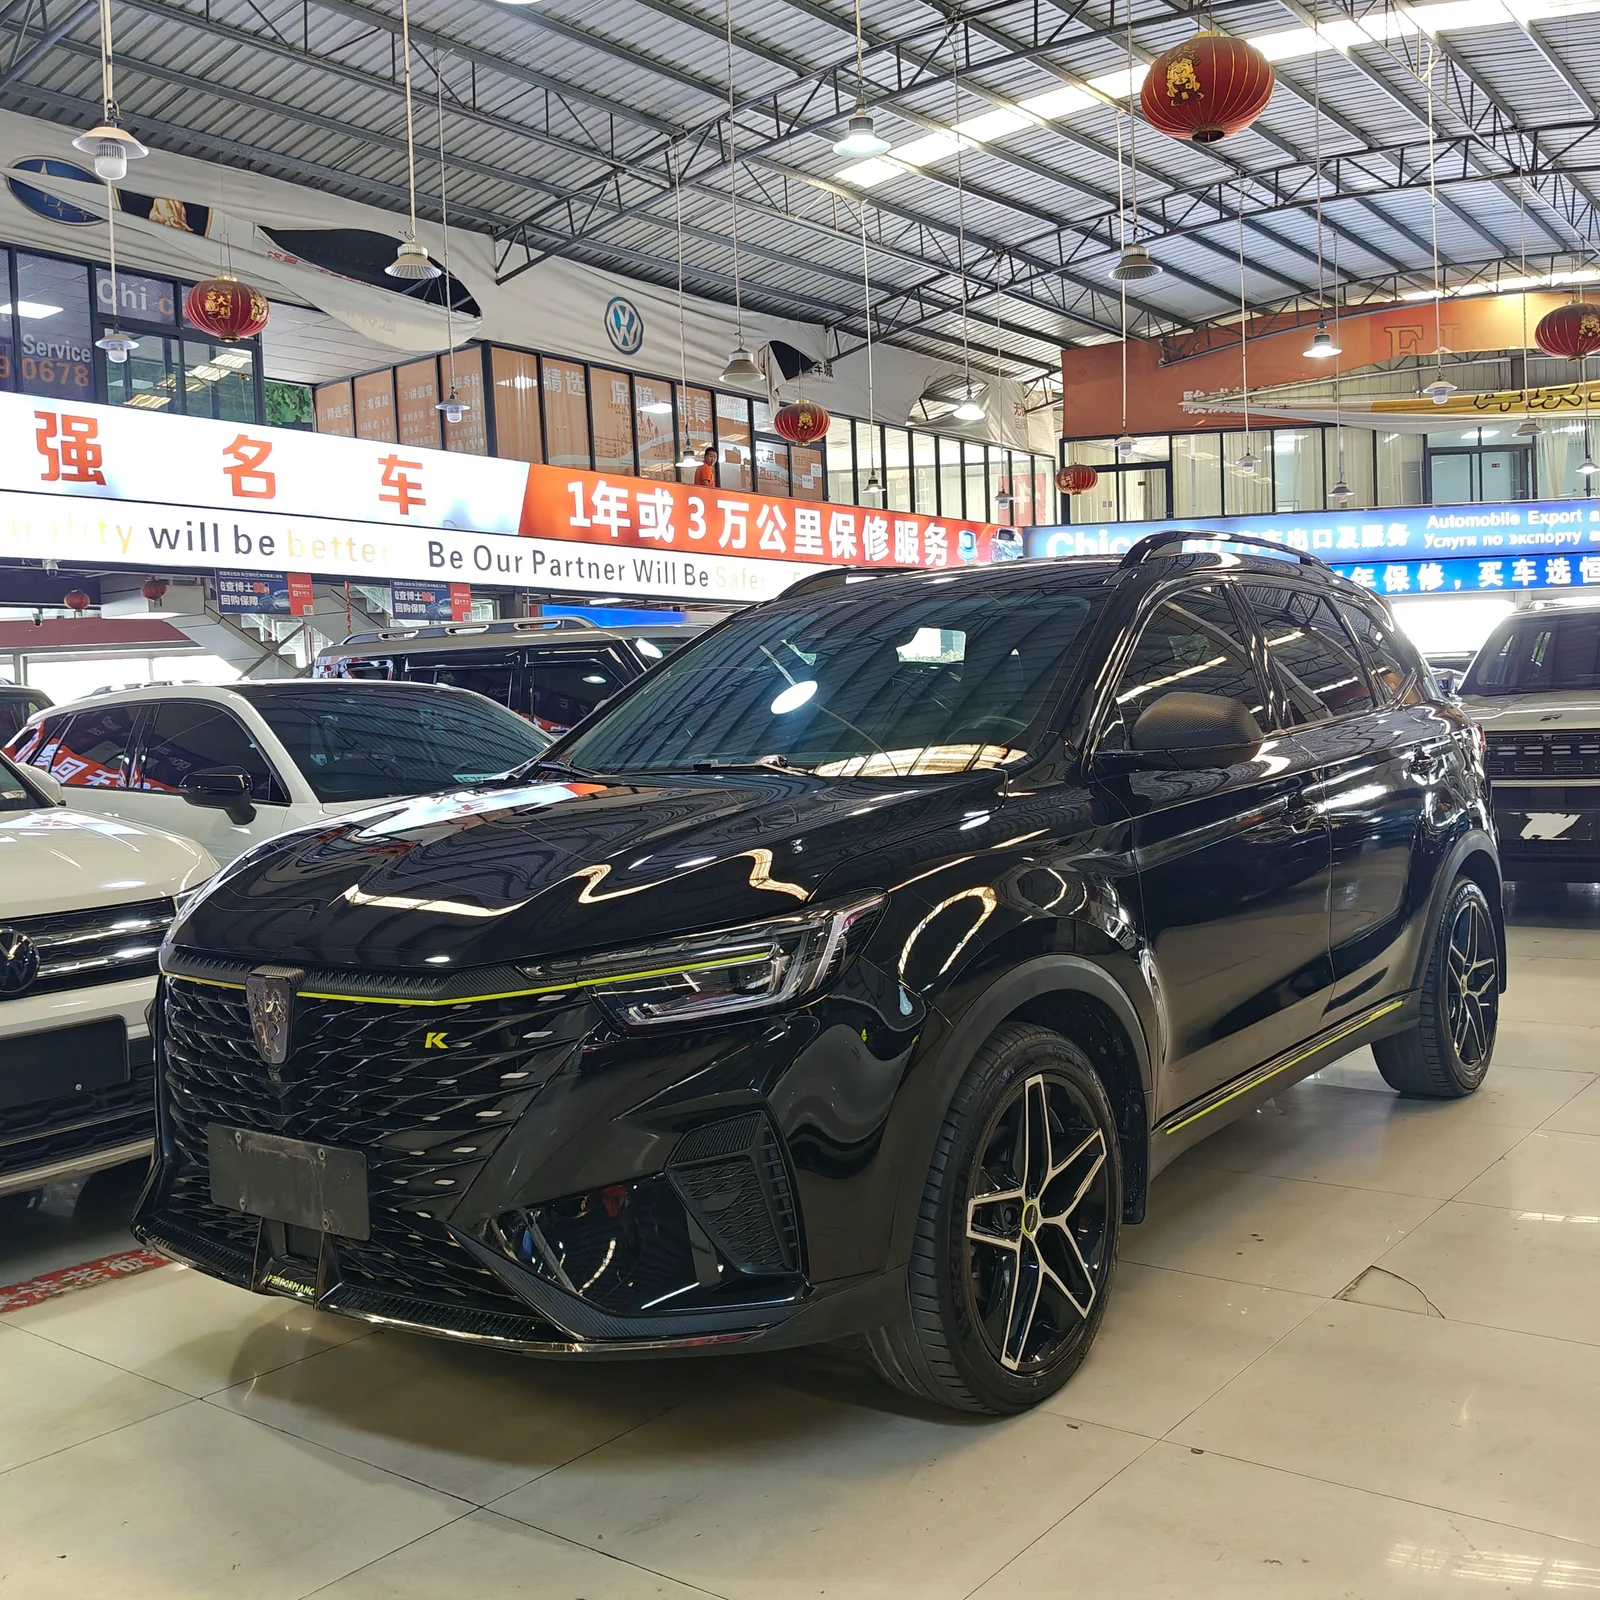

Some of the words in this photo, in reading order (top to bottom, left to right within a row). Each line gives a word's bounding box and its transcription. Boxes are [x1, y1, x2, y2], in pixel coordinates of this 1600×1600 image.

[22, 334, 91, 364] Service
[22, 359, 90, 388] 0678
[1427, 512, 1521, 529] Automobile
[1528, 509, 1583, 527] Export
[1483, 534, 1503, 546] по
[1509, 530, 1582, 547] экспорту
[149, 521, 220, 553] will
[233, 524, 276, 556] be
[287, 528, 390, 563] better
[429, 540, 463, 570] Be
[473, 545, 523, 574] Our
[532, 549, 626, 583] Partner
[633, 557, 677, 585] Will
[684, 563, 709, 587] Be
[425, 1032, 451, 1049] K
[267, 1274, 316, 1296] PERFORMANC
